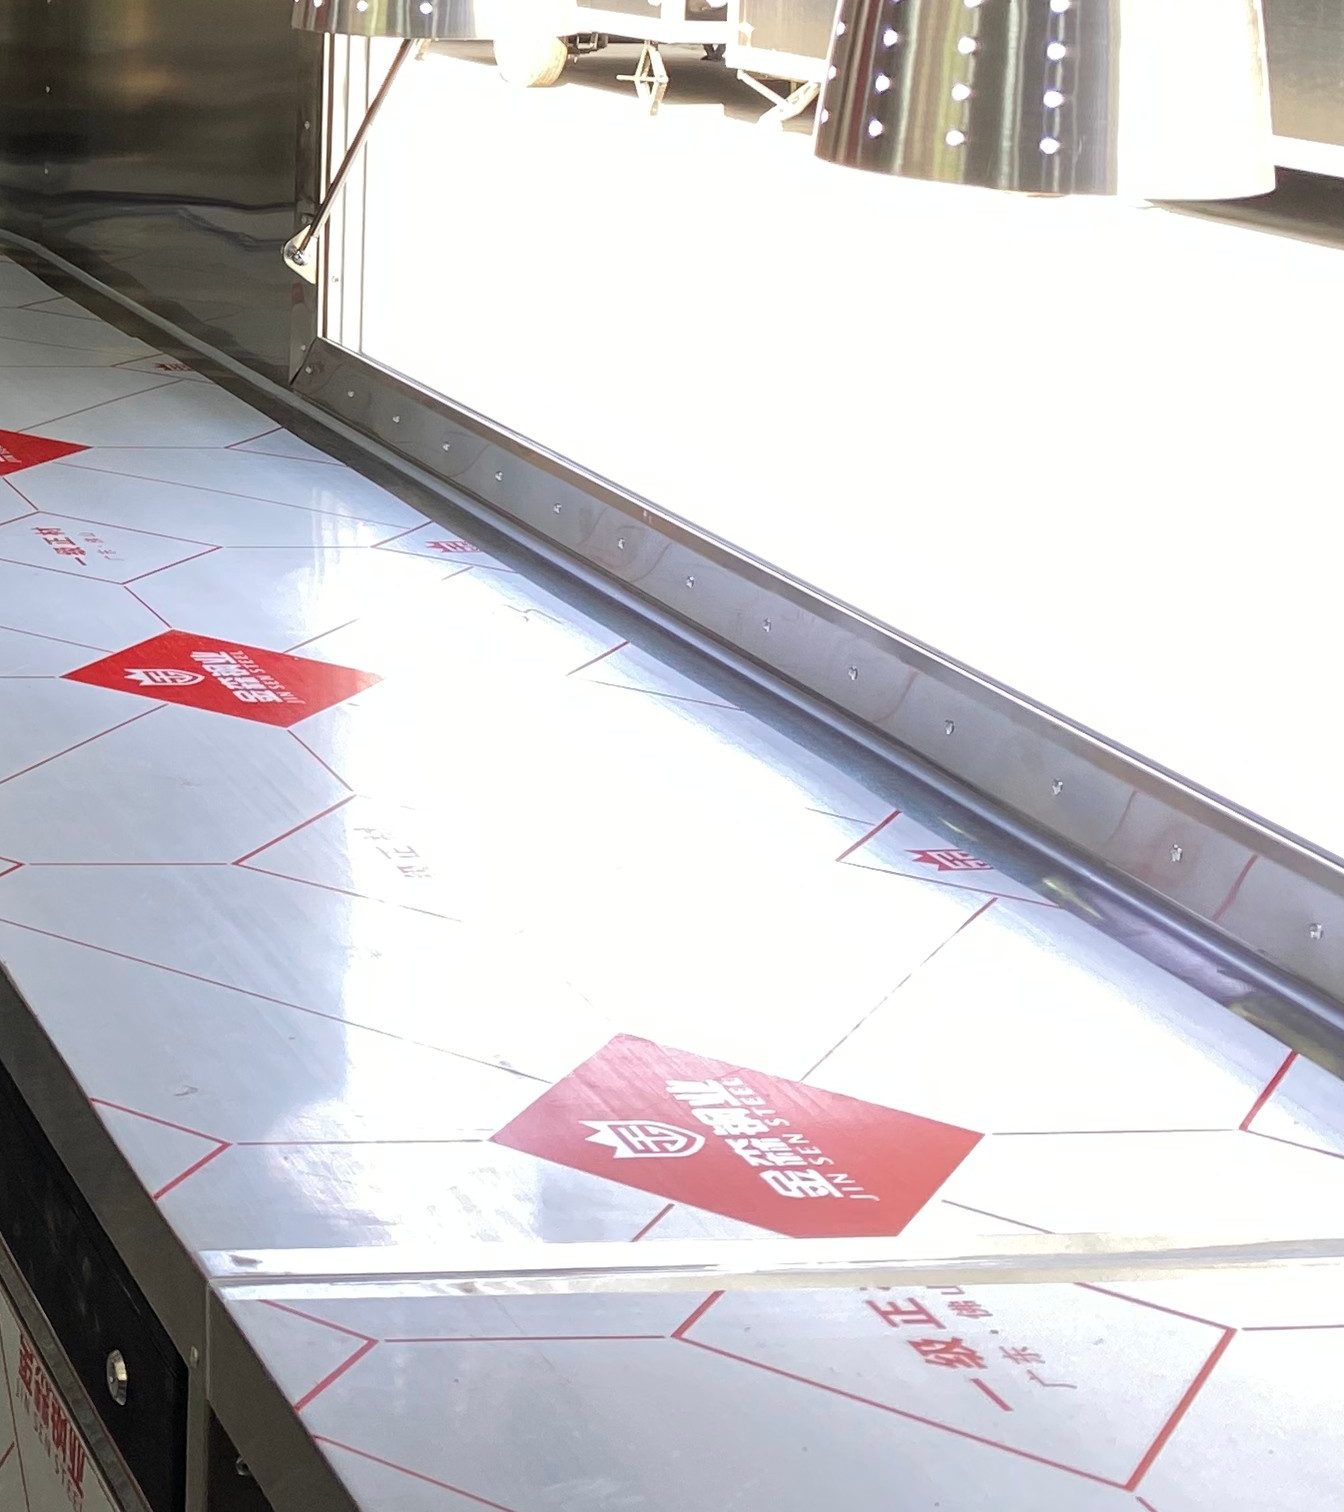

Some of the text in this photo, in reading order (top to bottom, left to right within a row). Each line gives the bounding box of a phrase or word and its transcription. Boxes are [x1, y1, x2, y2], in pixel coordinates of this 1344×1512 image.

[31, 527, 87, 566] 一级正材
[230, 651, 307, 704] JIN SEN STEEL
[721, 1078, 880, 1202] JIN SEN STEEL
[860, 1287, 1012, 1411] 一级正
